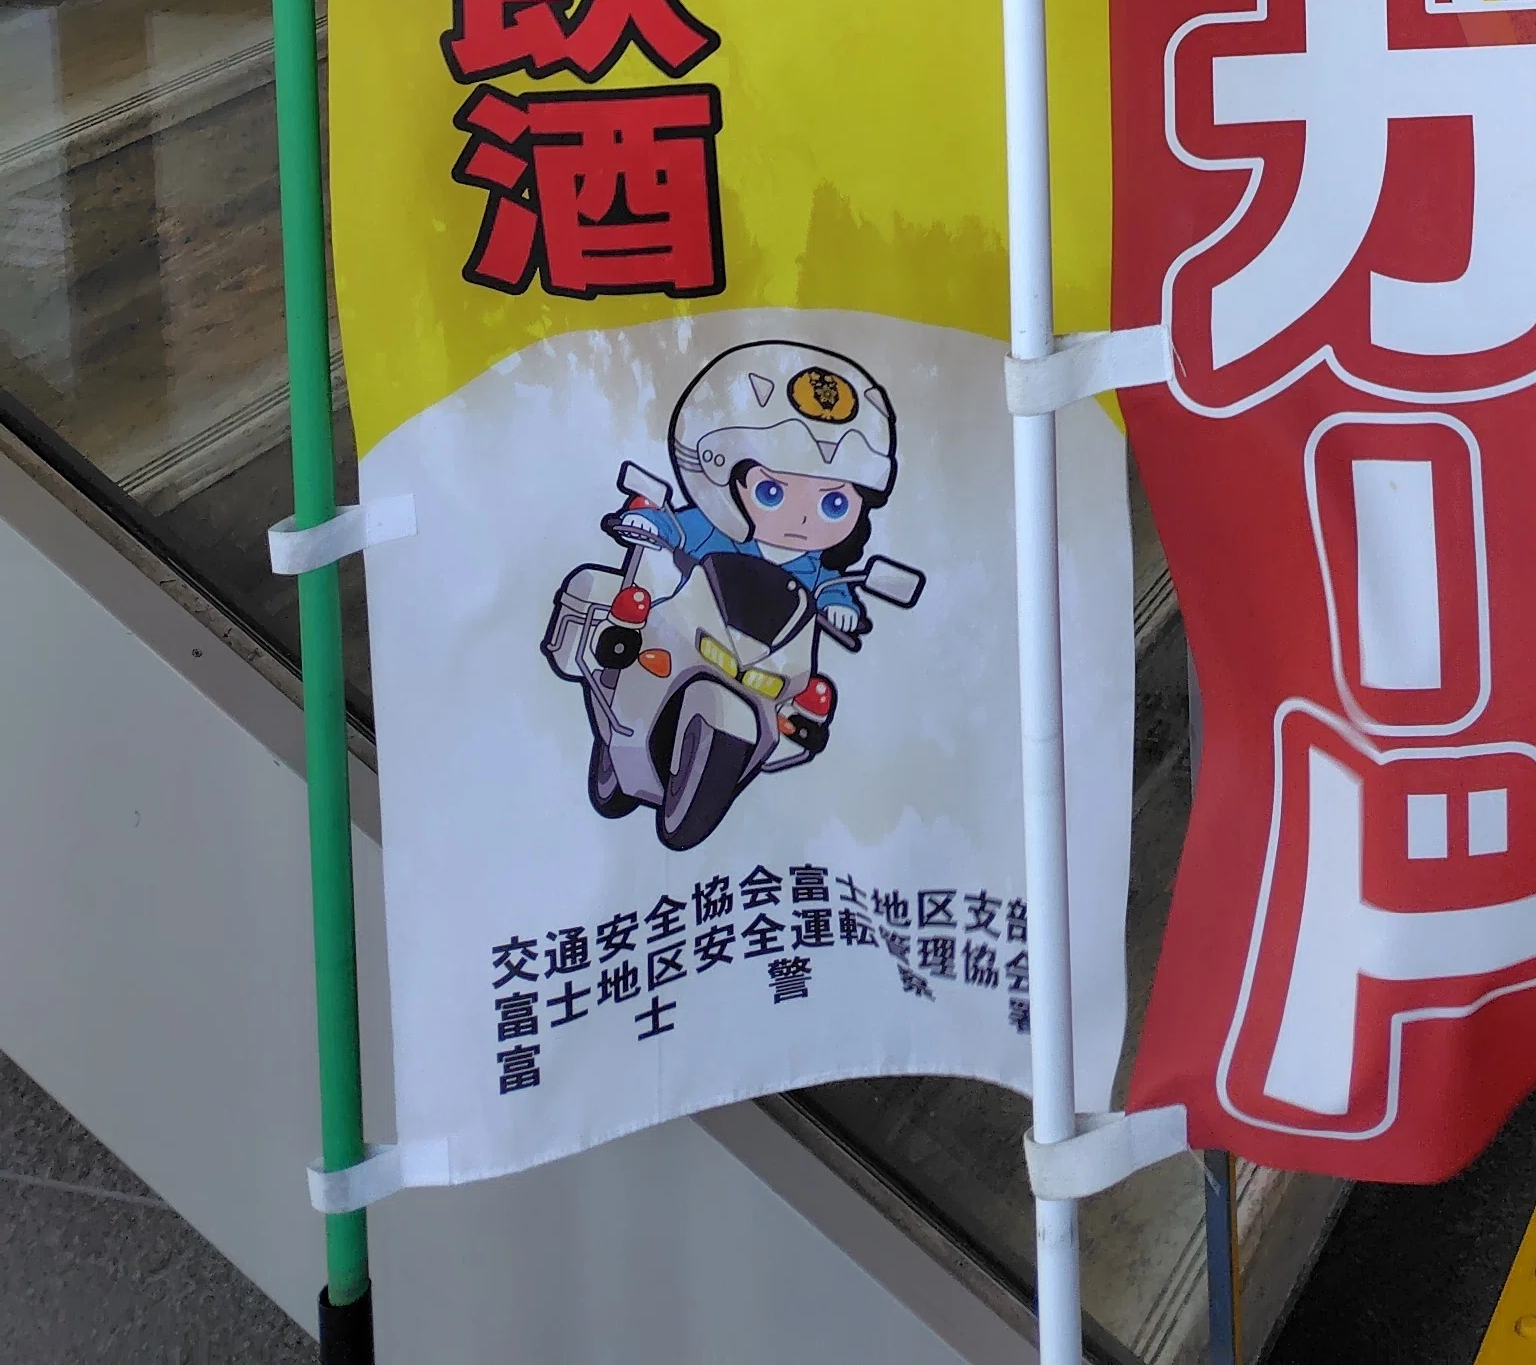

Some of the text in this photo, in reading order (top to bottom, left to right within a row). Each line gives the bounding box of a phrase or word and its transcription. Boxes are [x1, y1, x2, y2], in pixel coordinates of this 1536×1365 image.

[490, 862, 1030, 991] 交通安全協会富士地区支部
